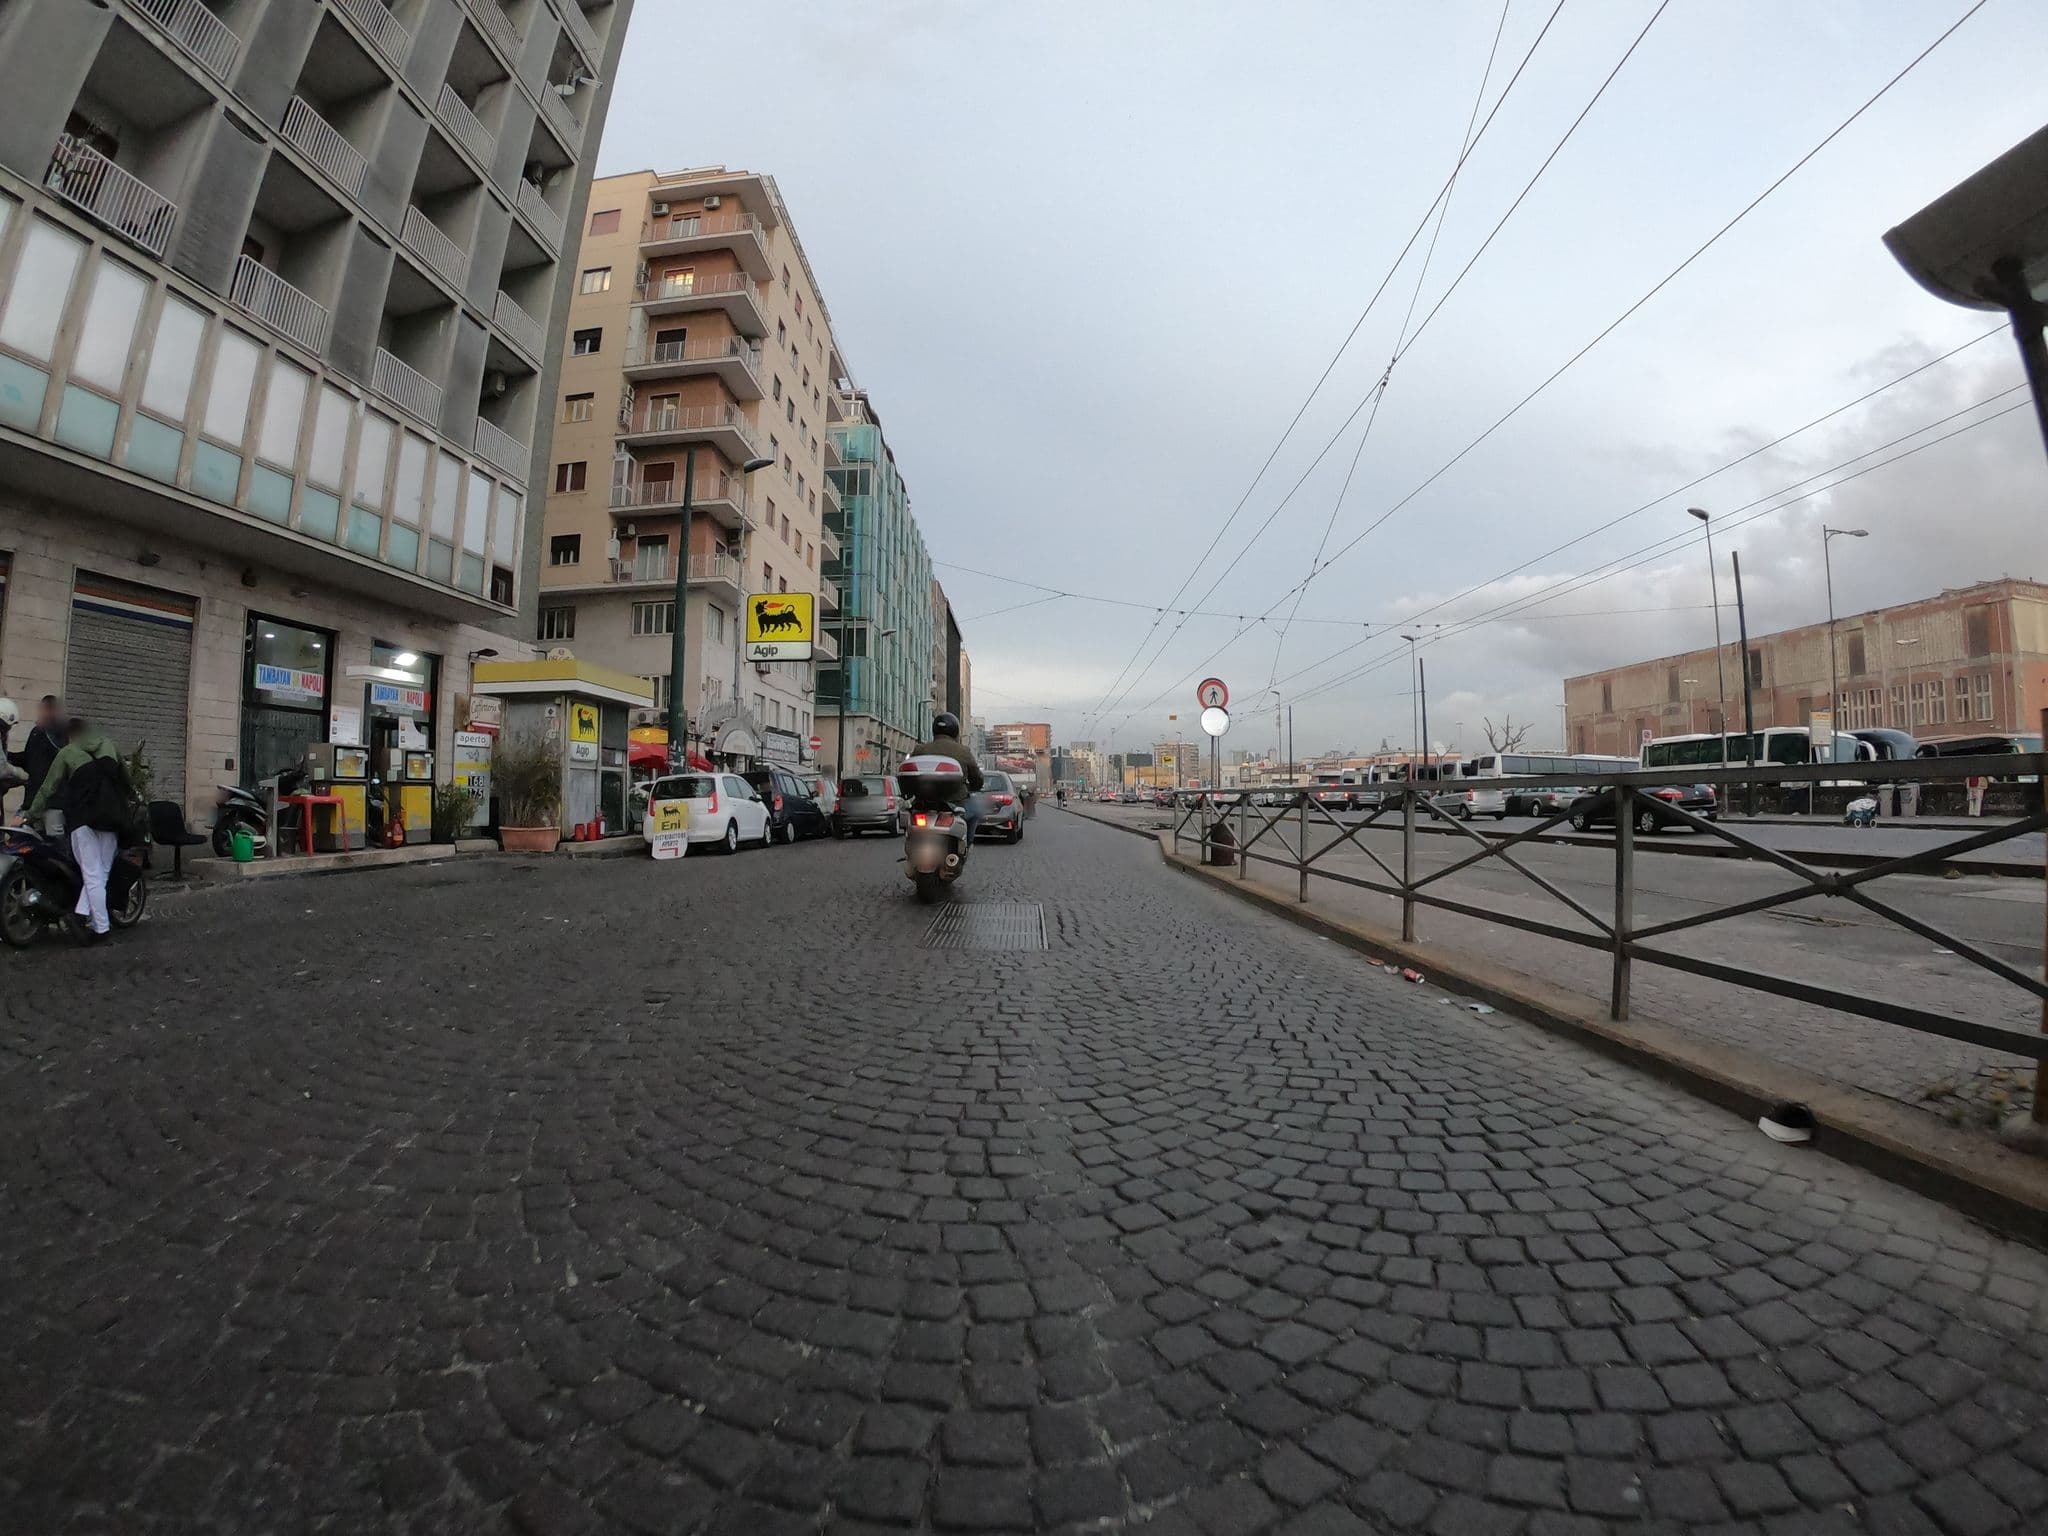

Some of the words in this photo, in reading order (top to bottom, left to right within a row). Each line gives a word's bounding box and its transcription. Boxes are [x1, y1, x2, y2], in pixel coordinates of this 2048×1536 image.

[753, 644, 779, 658] Agip
[259, 665, 291, 686] TAMBAYAN
[301, 672, 323, 694] NAPOLI
[406, 690, 423, 707] NAPOLI
[460, 735, 487, 745] aperto
[575, 743, 590, 758] Agip
[661, 819, 681, 831] Eni
